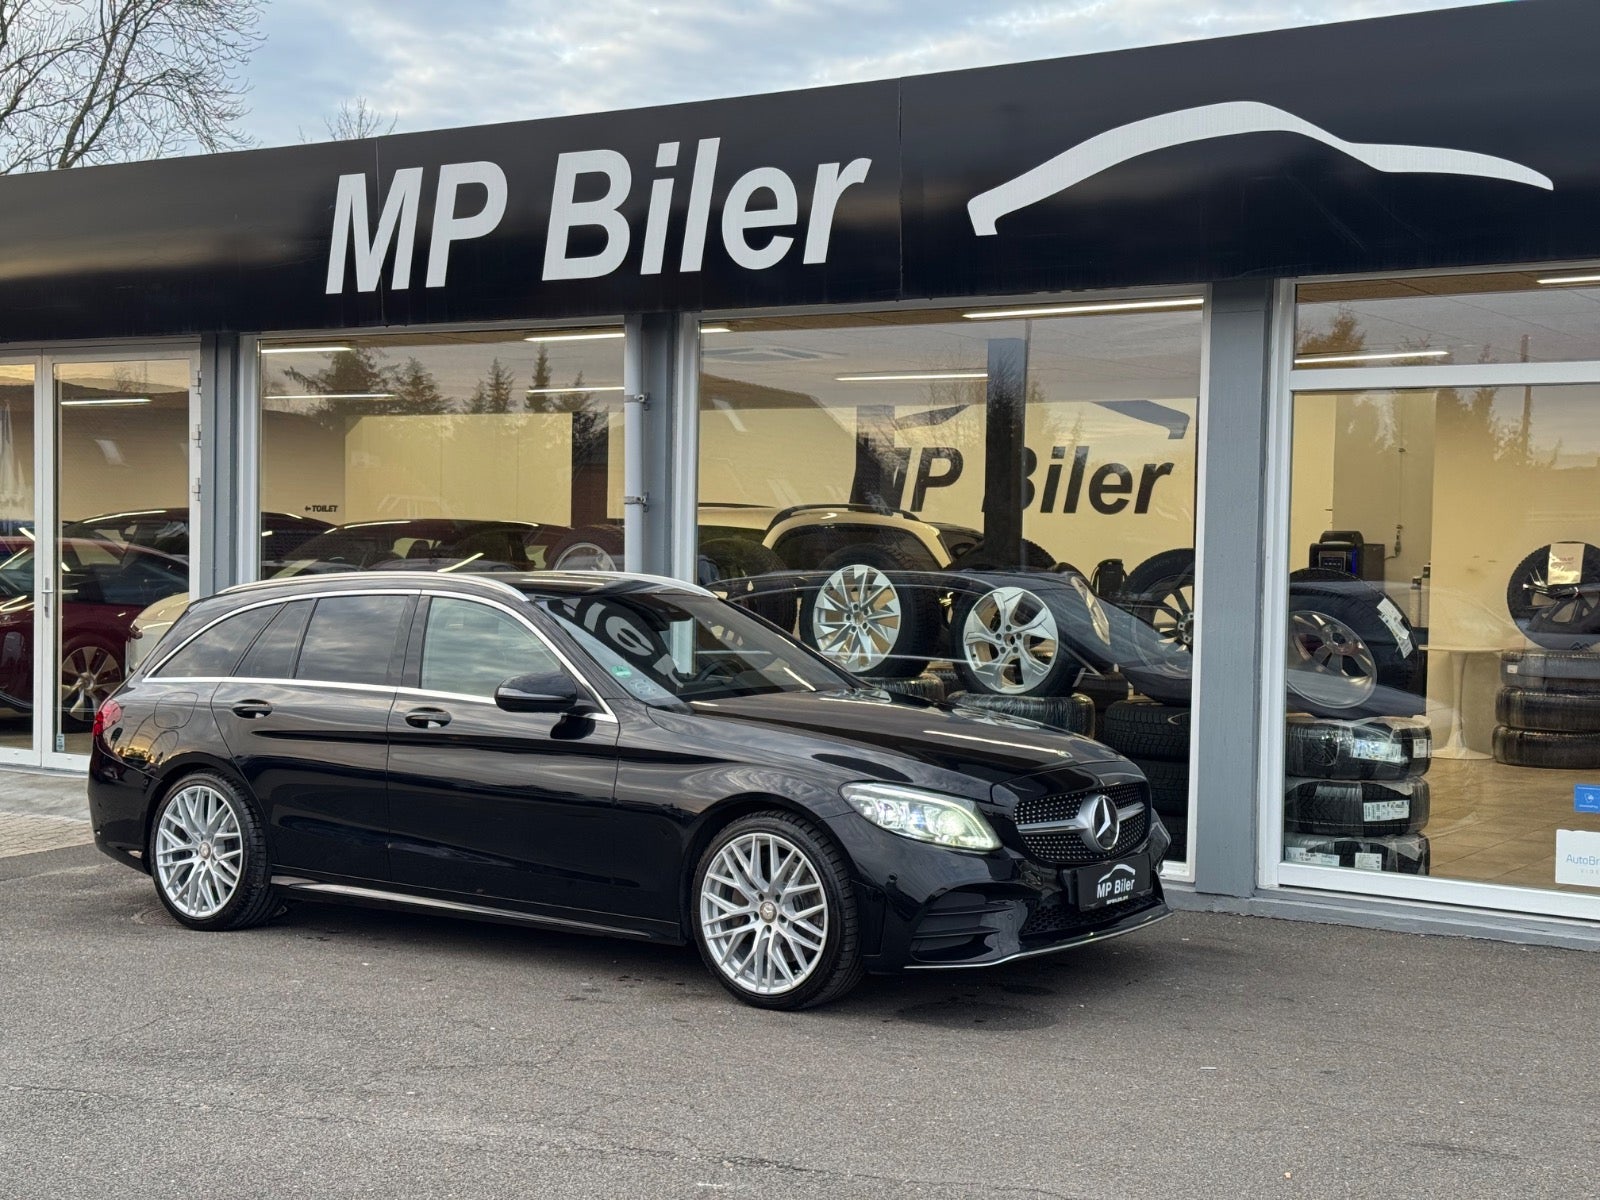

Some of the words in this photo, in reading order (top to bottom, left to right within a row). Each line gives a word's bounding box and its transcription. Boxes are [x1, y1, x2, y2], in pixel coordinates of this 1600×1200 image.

[325, 161, 508, 294] MP
[541, 137, 872, 281] Biler
[312, 504, 338, 512] TOILET
[1096, 881, 1112, 899] MP
[1114, 878, 1135, 894] Biler
